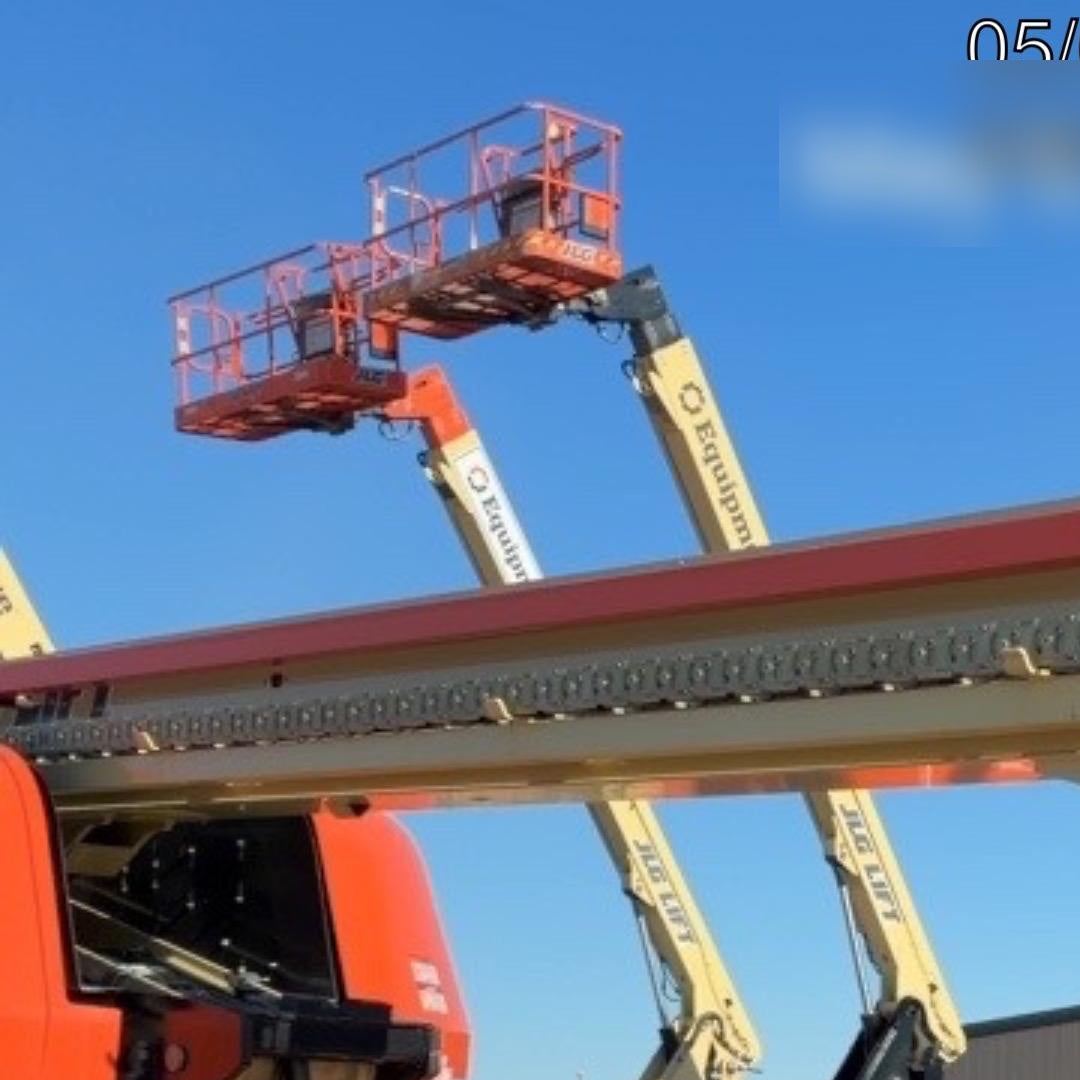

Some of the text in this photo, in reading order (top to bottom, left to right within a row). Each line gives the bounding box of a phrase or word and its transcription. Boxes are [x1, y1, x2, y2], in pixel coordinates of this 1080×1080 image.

[694, 419, 755, 549] Equipm
[632, 840, 695, 944] JLG LIFT
[840, 803, 901, 923] JLG LIFT
